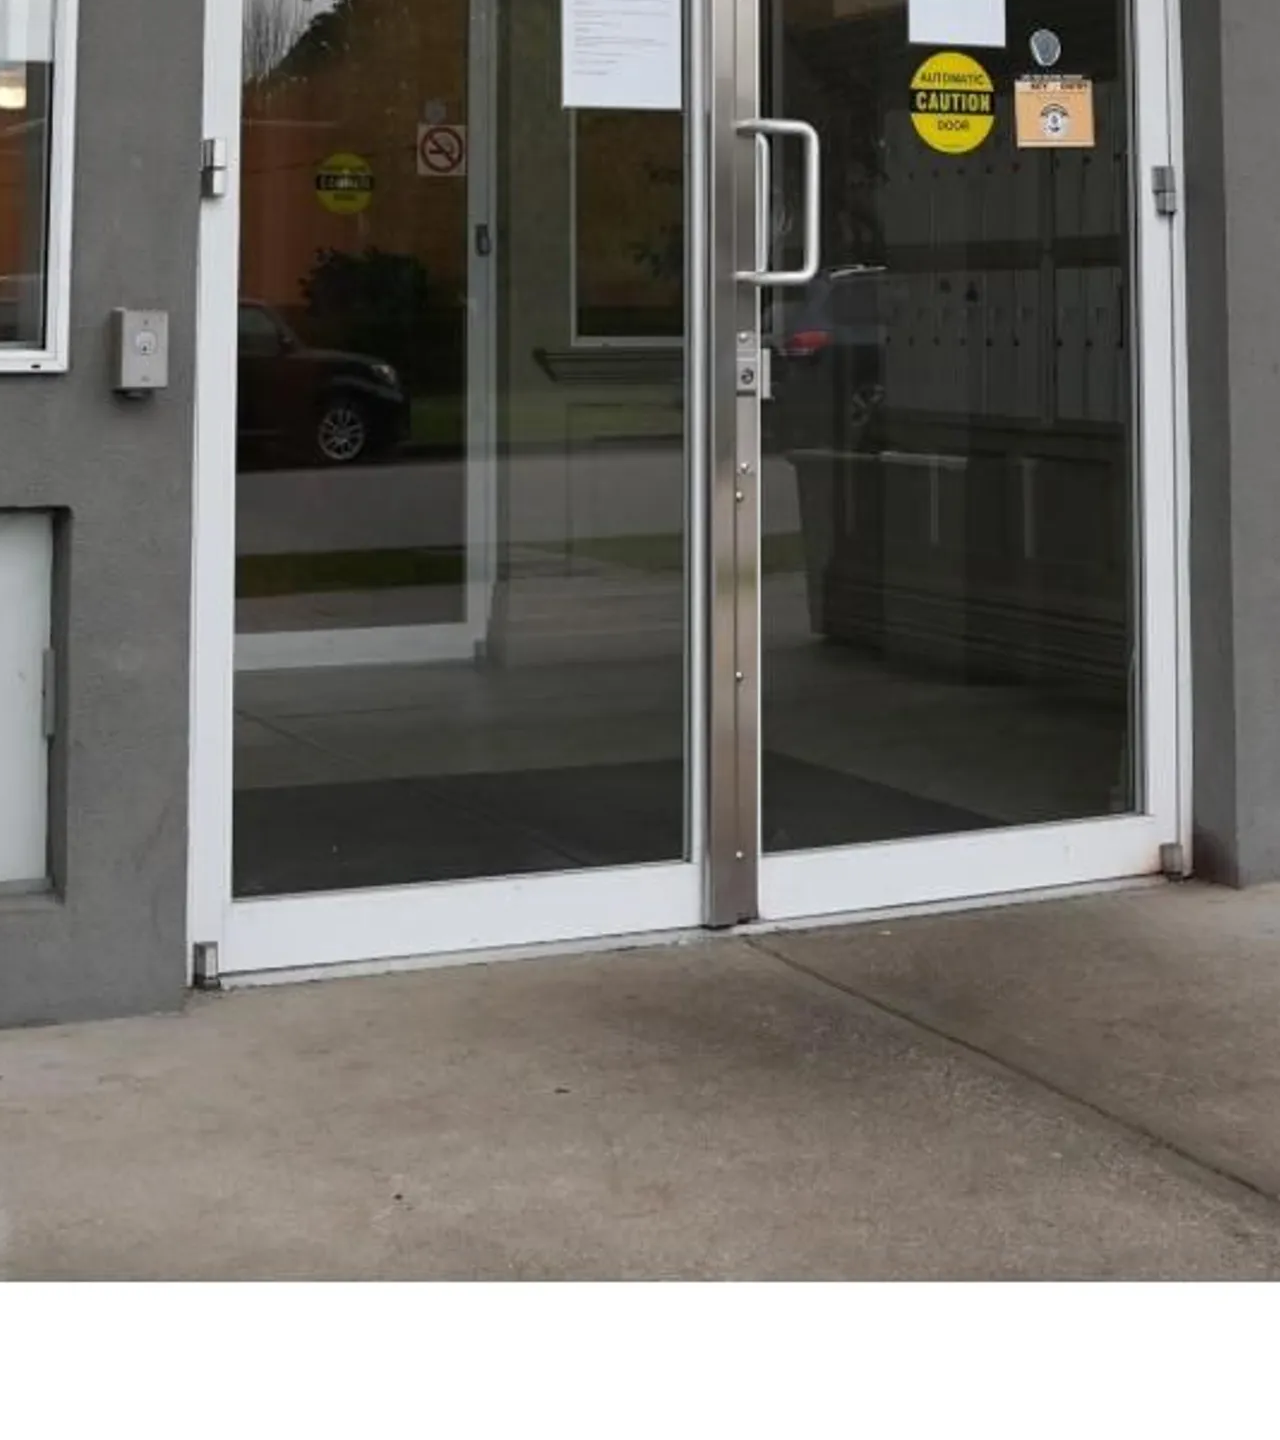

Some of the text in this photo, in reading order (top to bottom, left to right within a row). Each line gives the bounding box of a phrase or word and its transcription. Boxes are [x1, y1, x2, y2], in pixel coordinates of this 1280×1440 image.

[920, 72, 985, 86] AUTOMATIC
[915, 91, 990, 112] CAUTION
[937, 119, 970, 132] DOOR
